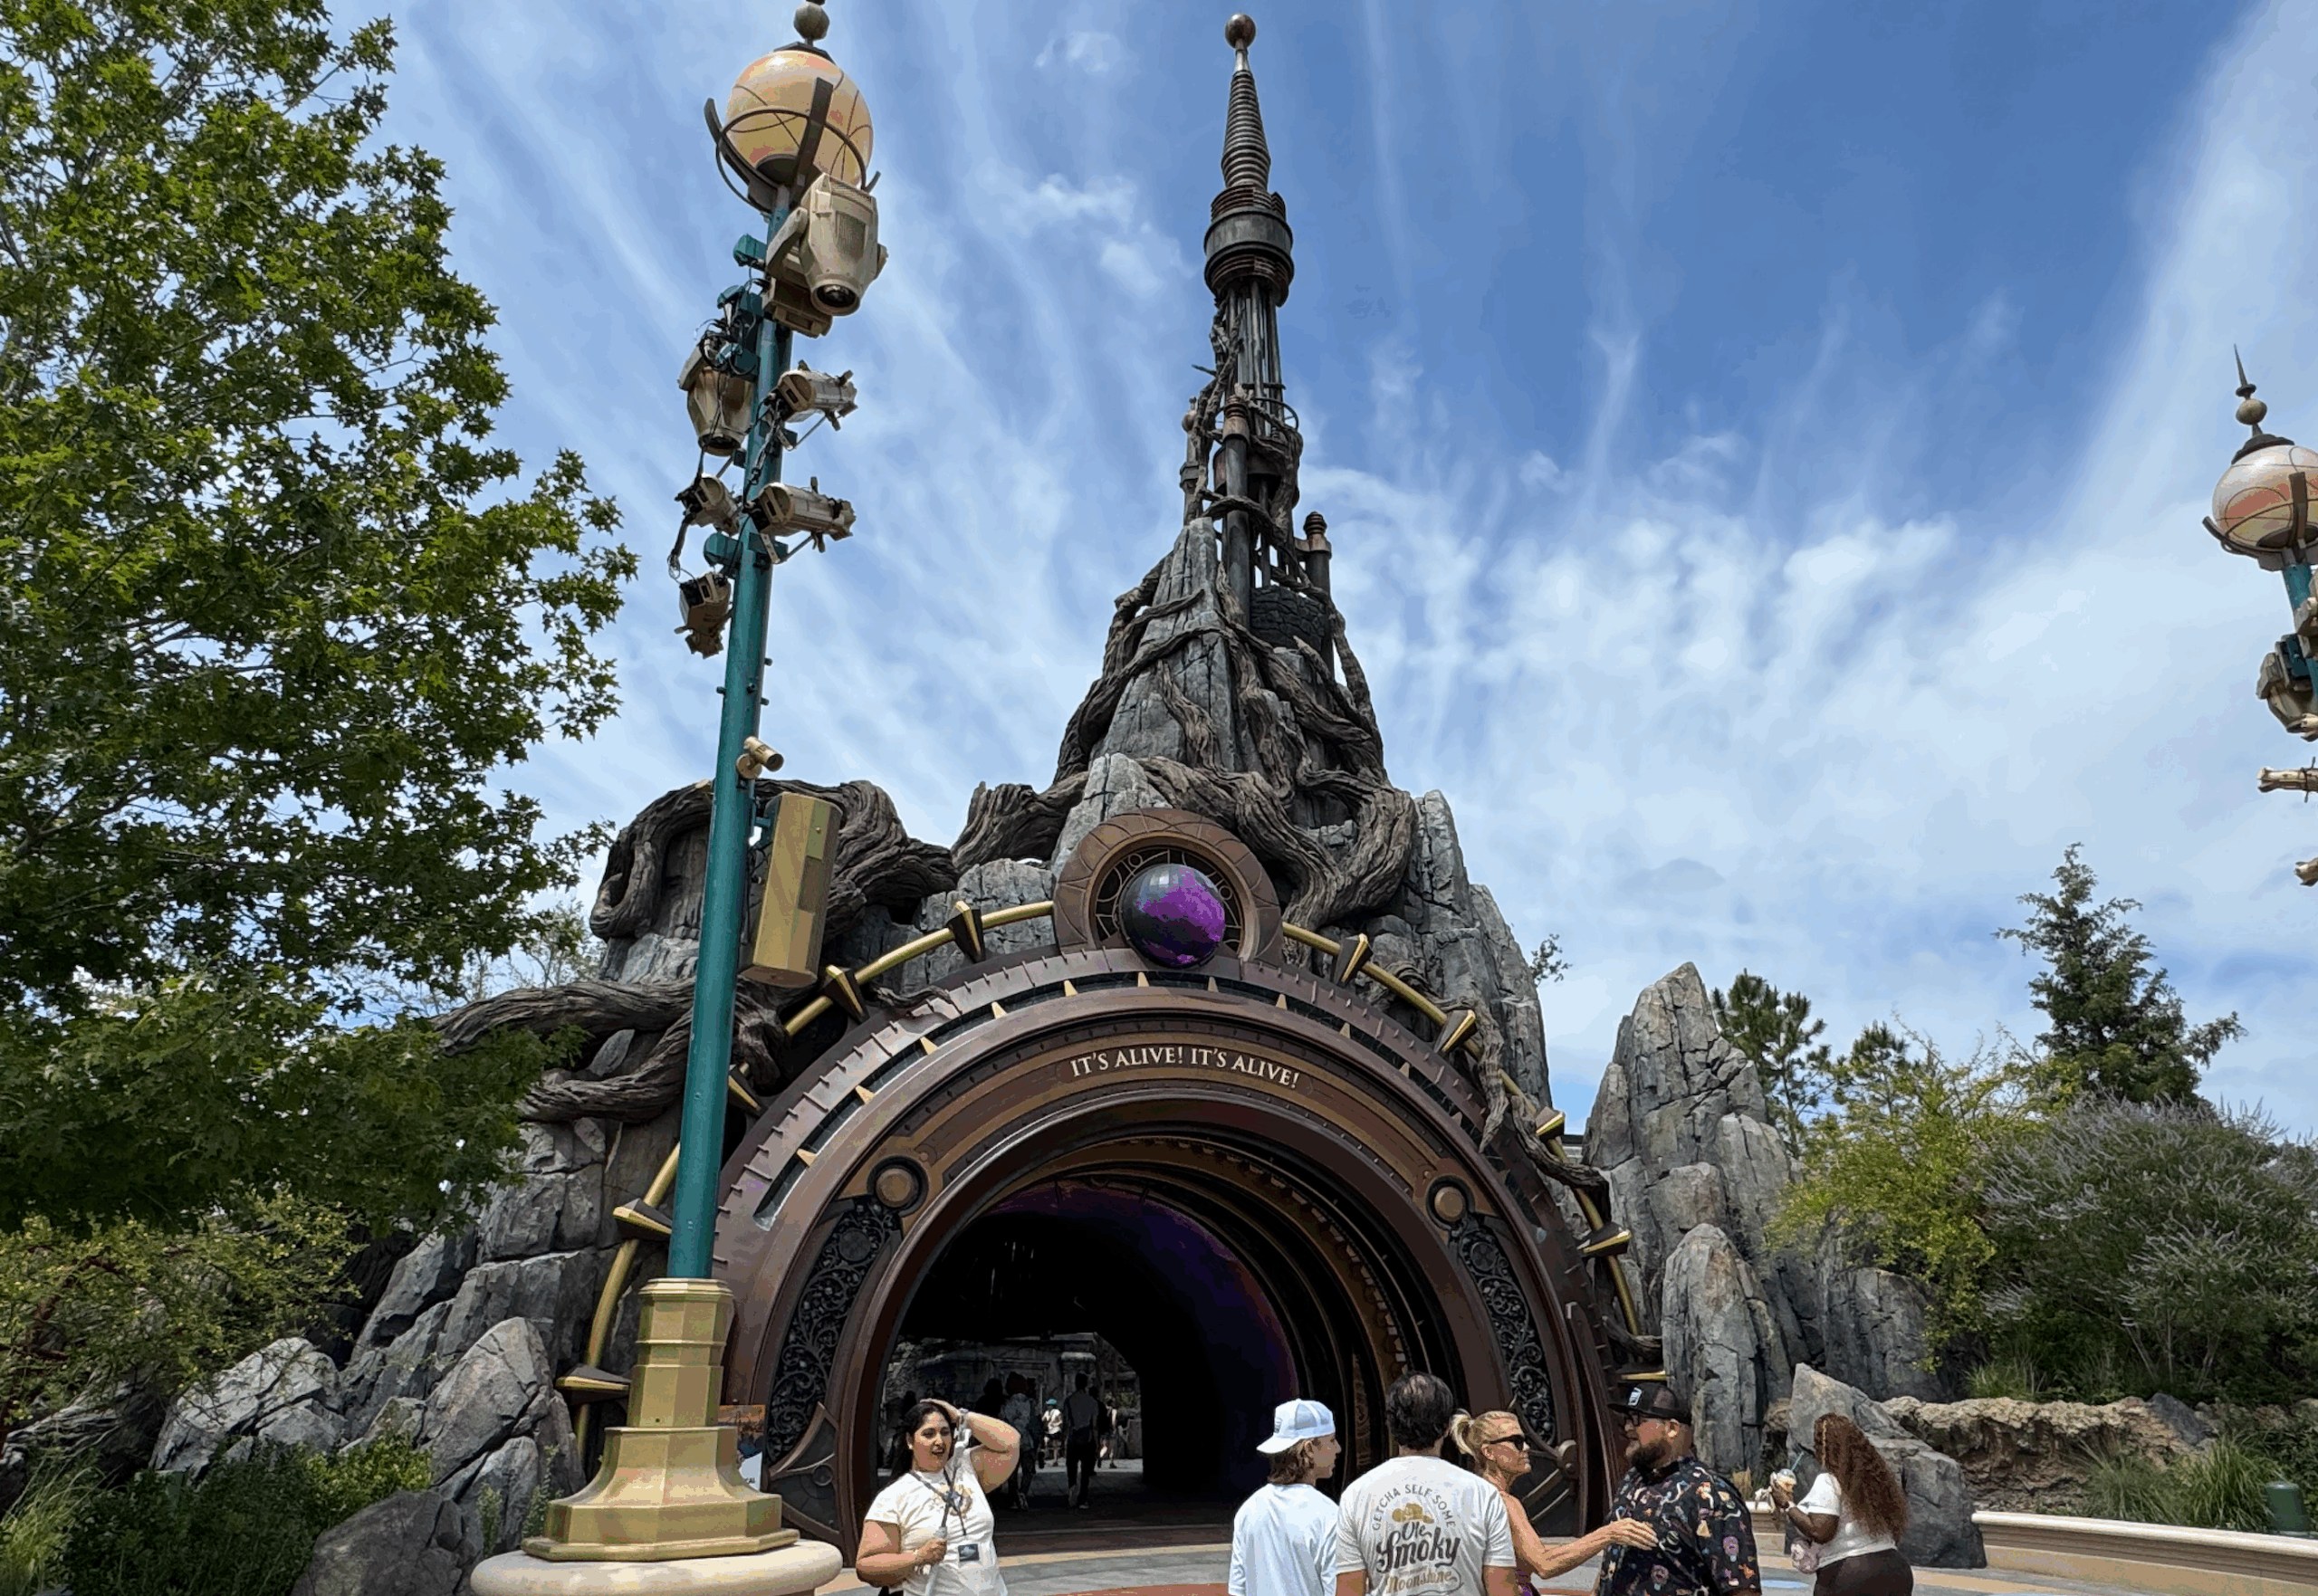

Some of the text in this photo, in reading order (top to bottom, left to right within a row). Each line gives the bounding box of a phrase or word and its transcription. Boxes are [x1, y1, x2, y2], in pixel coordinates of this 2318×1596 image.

[1070, 1046, 1299, 1089] IT'S ALIVE! IT'S ALIVE!
[1372, 1484, 1456, 1531] GETCHA SELF SOME
[1376, 1527, 1461, 1573] Smoky
[1403, 1521, 1432, 1541] Ole
[1385, 1570, 1458, 1594] Moonshine
